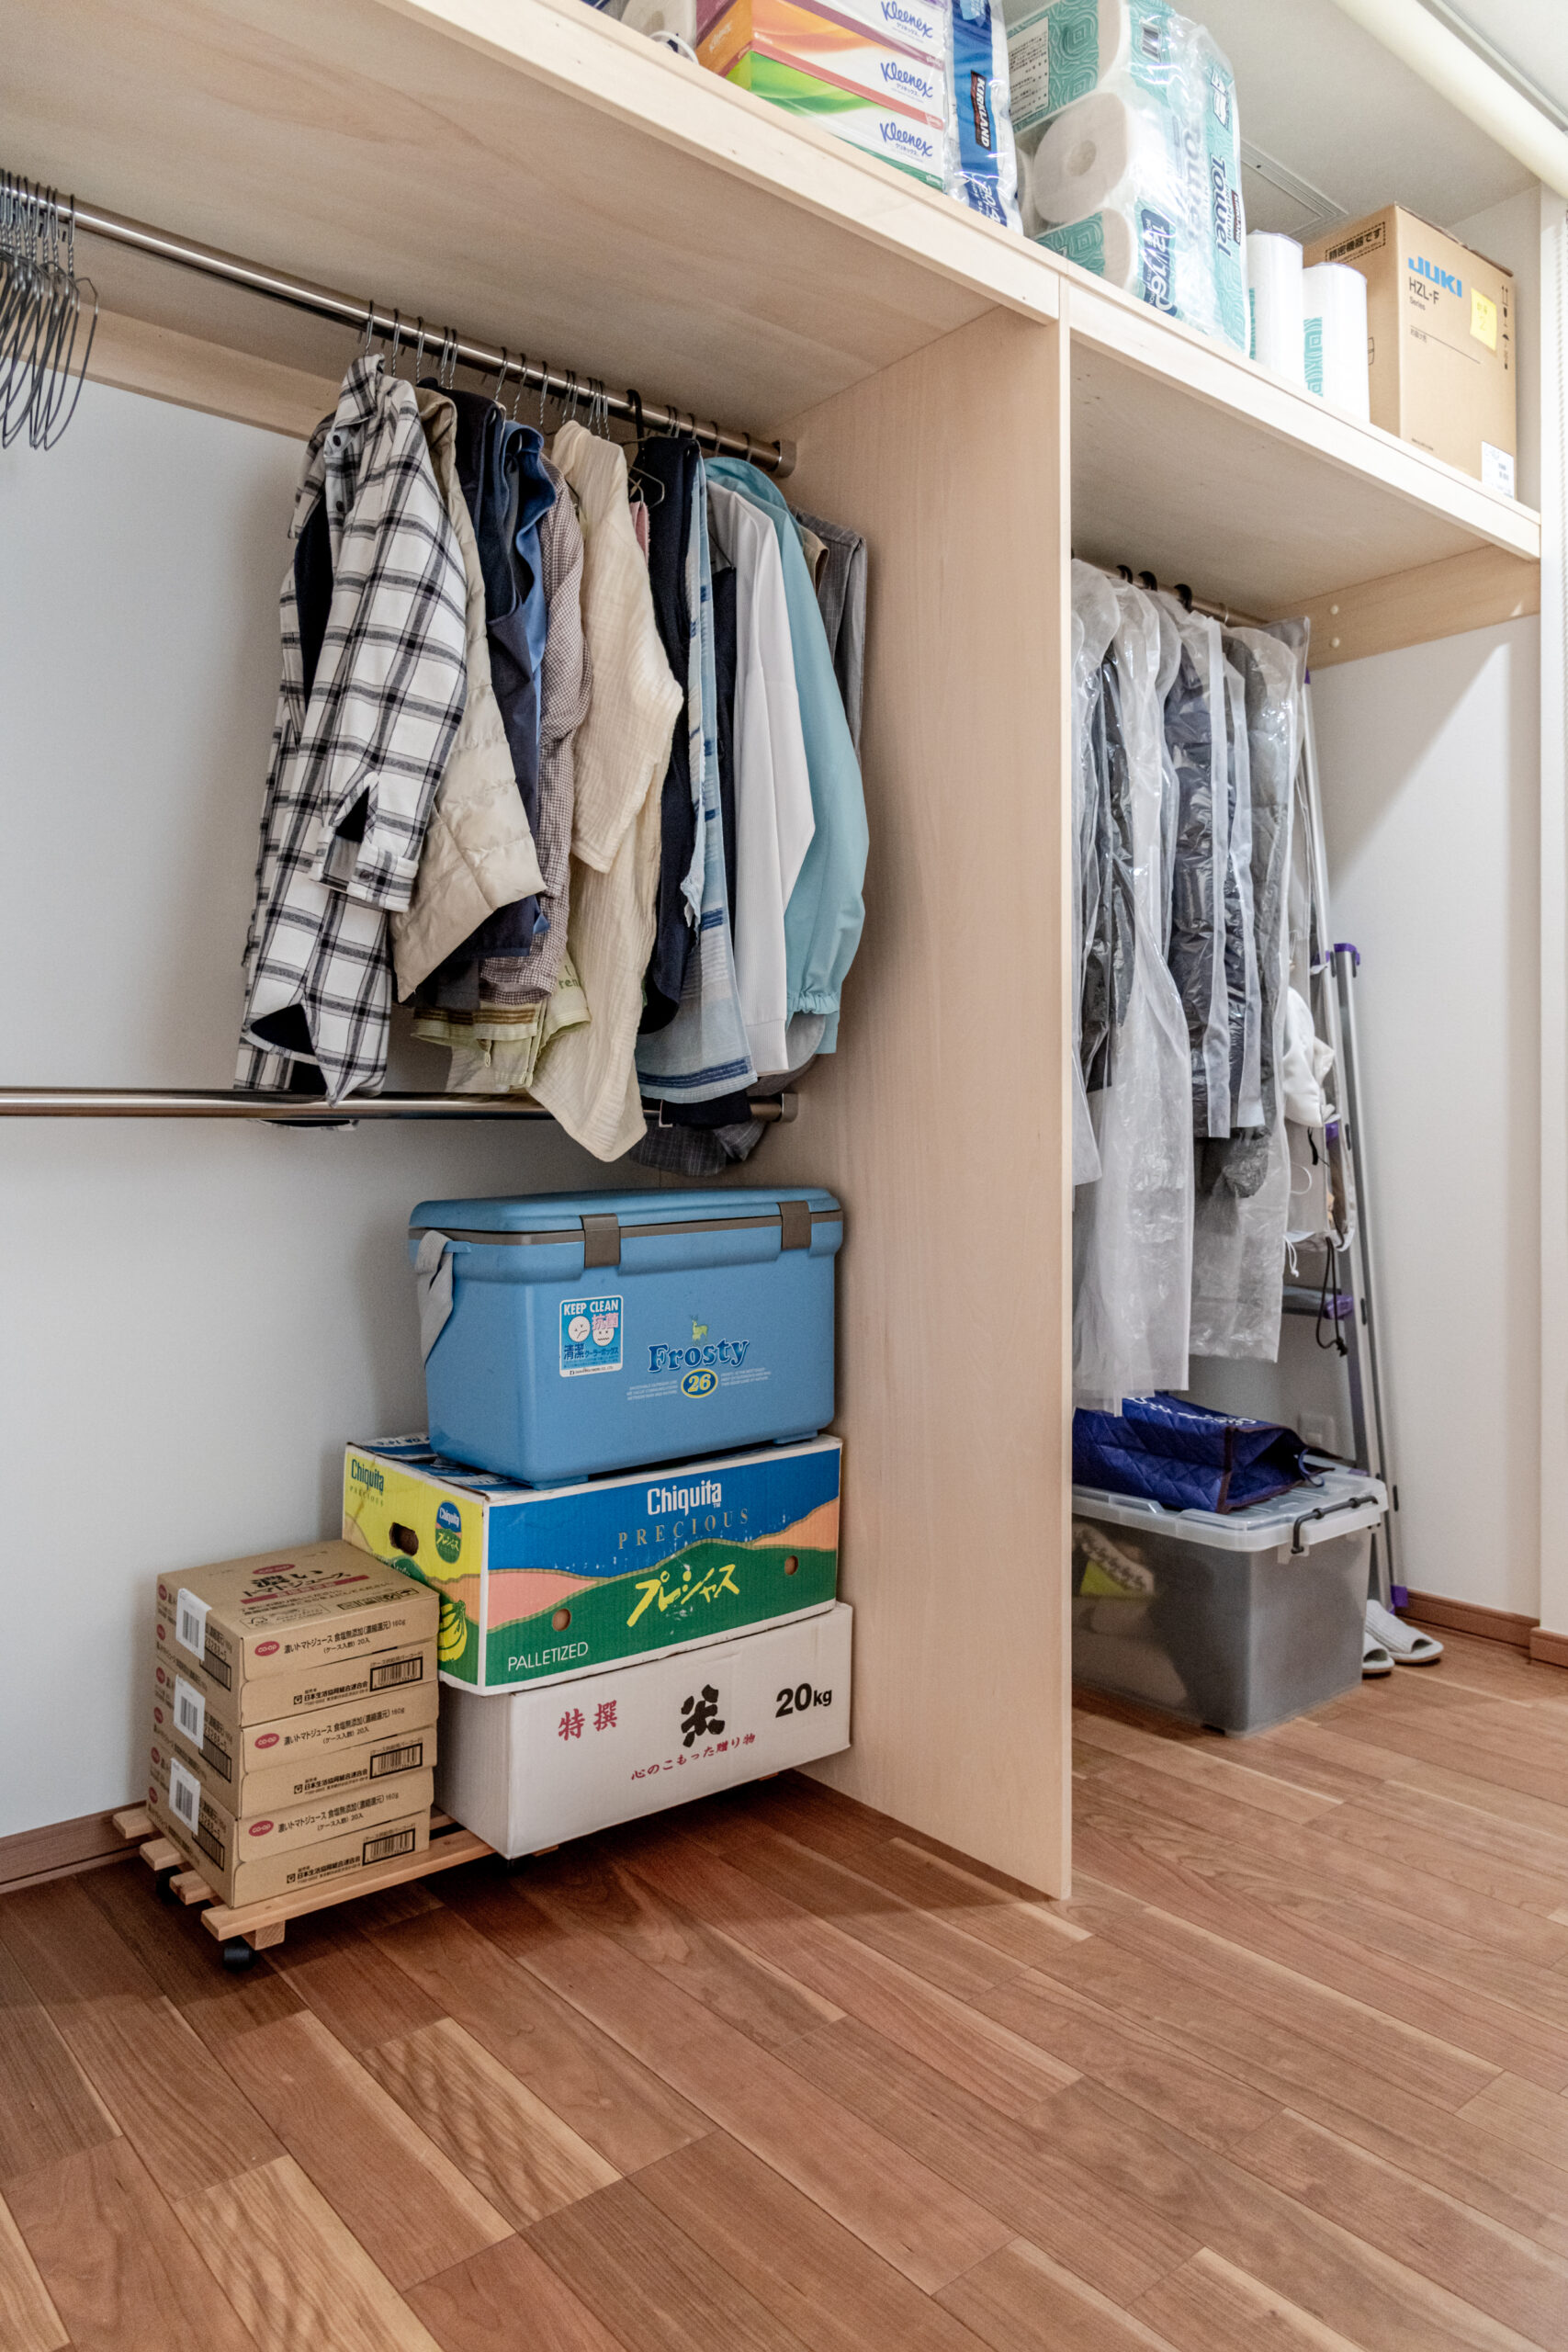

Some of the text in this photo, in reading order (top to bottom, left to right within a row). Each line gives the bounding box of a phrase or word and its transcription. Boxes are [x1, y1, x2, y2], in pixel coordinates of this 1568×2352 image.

[881, 1, 933, 39] Kleenex
[880, 62, 933, 98] Kleenex
[976, 77, 990, 148] KIRKLAND
[879, 122, 933, 157] Kleenex
[1212, 155, 1231, 256] Towel
[1407, 255, 1462, 299] JUKI
[1409, 277, 1439, 304] HZL-F
[563, 1299, 619, 1316] KEEP CLEAN
[592, 1312, 619, 1330] 抗菌
[647, 1338, 750, 1373] Frosty
[687, 1374, 712, 1393] 26
[351, 1458, 384, 1492] Chiquita
[648, 1479, 722, 1516] Chiquita
[439, 1507, 459, 1528] Chiquita
[618, 1508, 749, 1550] PRECIOUS
[626, 1564, 740, 1627] プレシャス
[507, 1642, 589, 1671] PALLETIZED
[775, 1682, 832, 1719] 20kg
[558, 1700, 618, 1741] 特撰
[630, 1733, 756, 1781] 心のこもった贈り物
